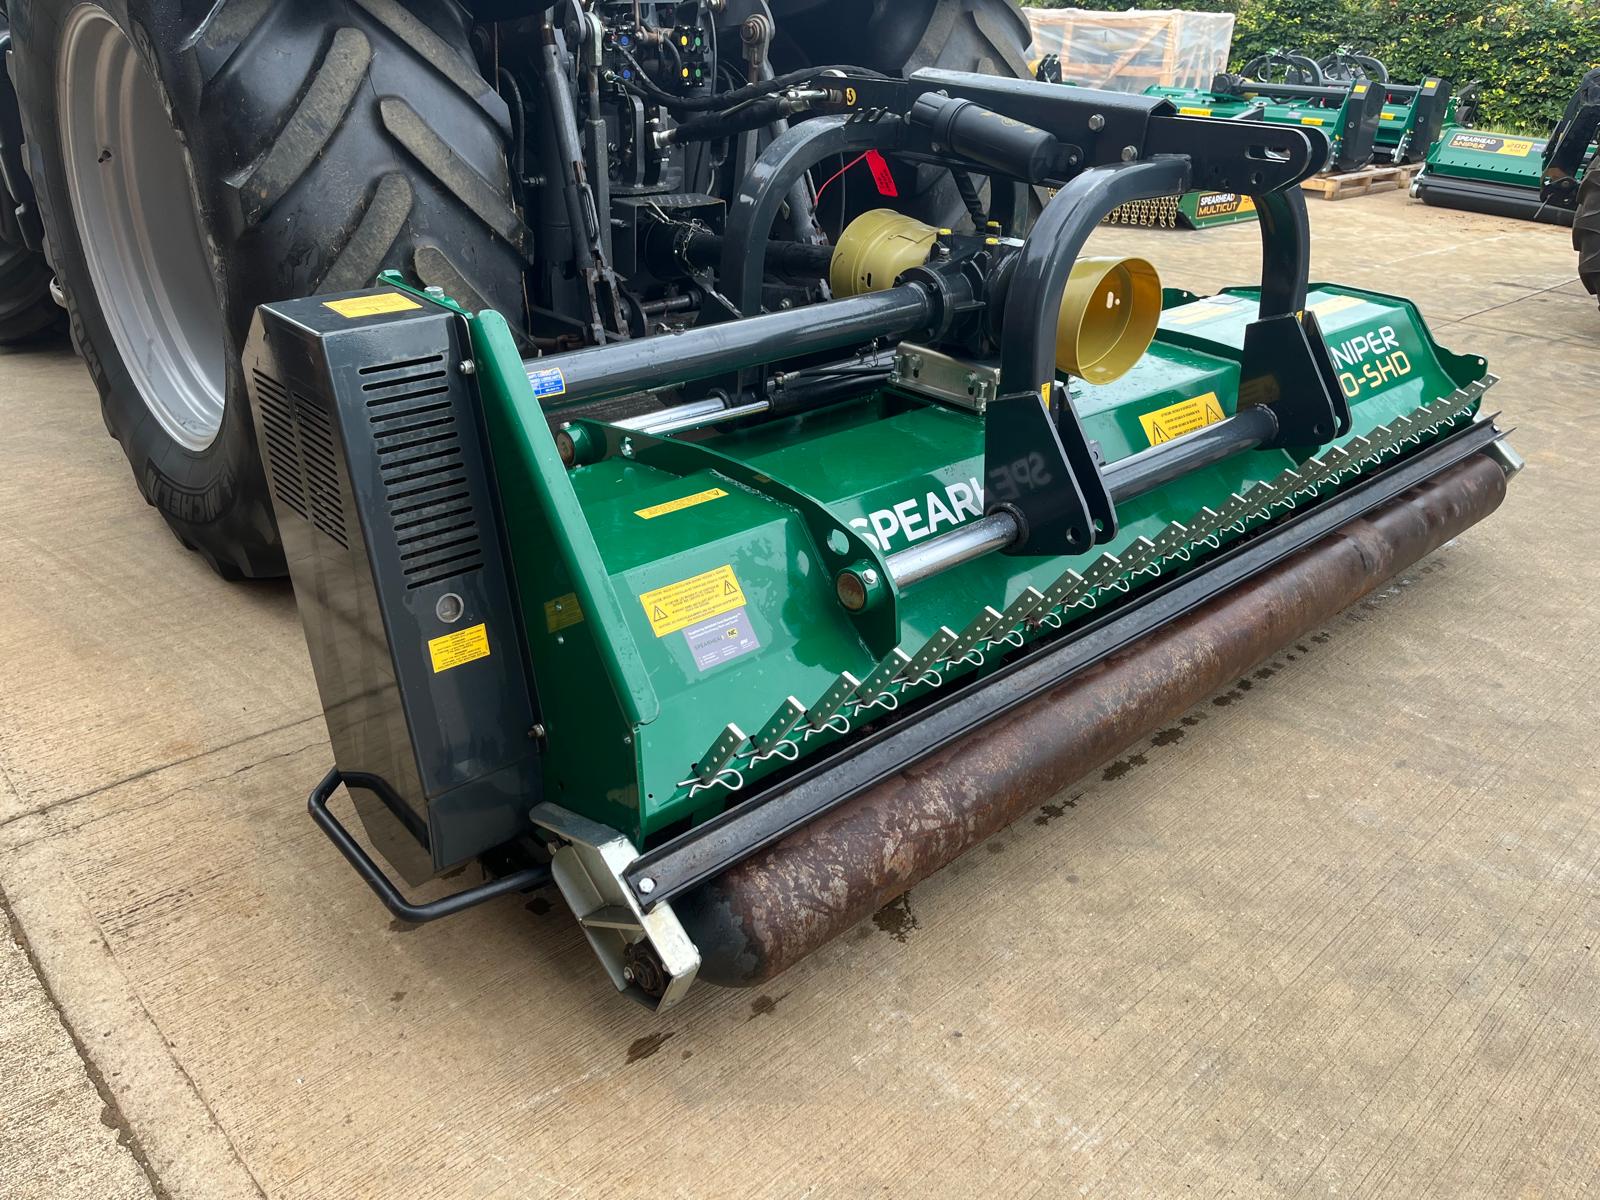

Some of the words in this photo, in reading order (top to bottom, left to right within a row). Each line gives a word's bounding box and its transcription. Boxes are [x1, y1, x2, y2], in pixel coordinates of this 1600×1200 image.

[1452, 140, 1486, 149] SNIPER
[1455, 135, 1496, 145] SPEARHEAD
[1200, 193, 1236, 206] SPEARHEAD
[1198, 201, 1238, 216] MULTICUT
[1330, 325, 1400, 370] NIPER
